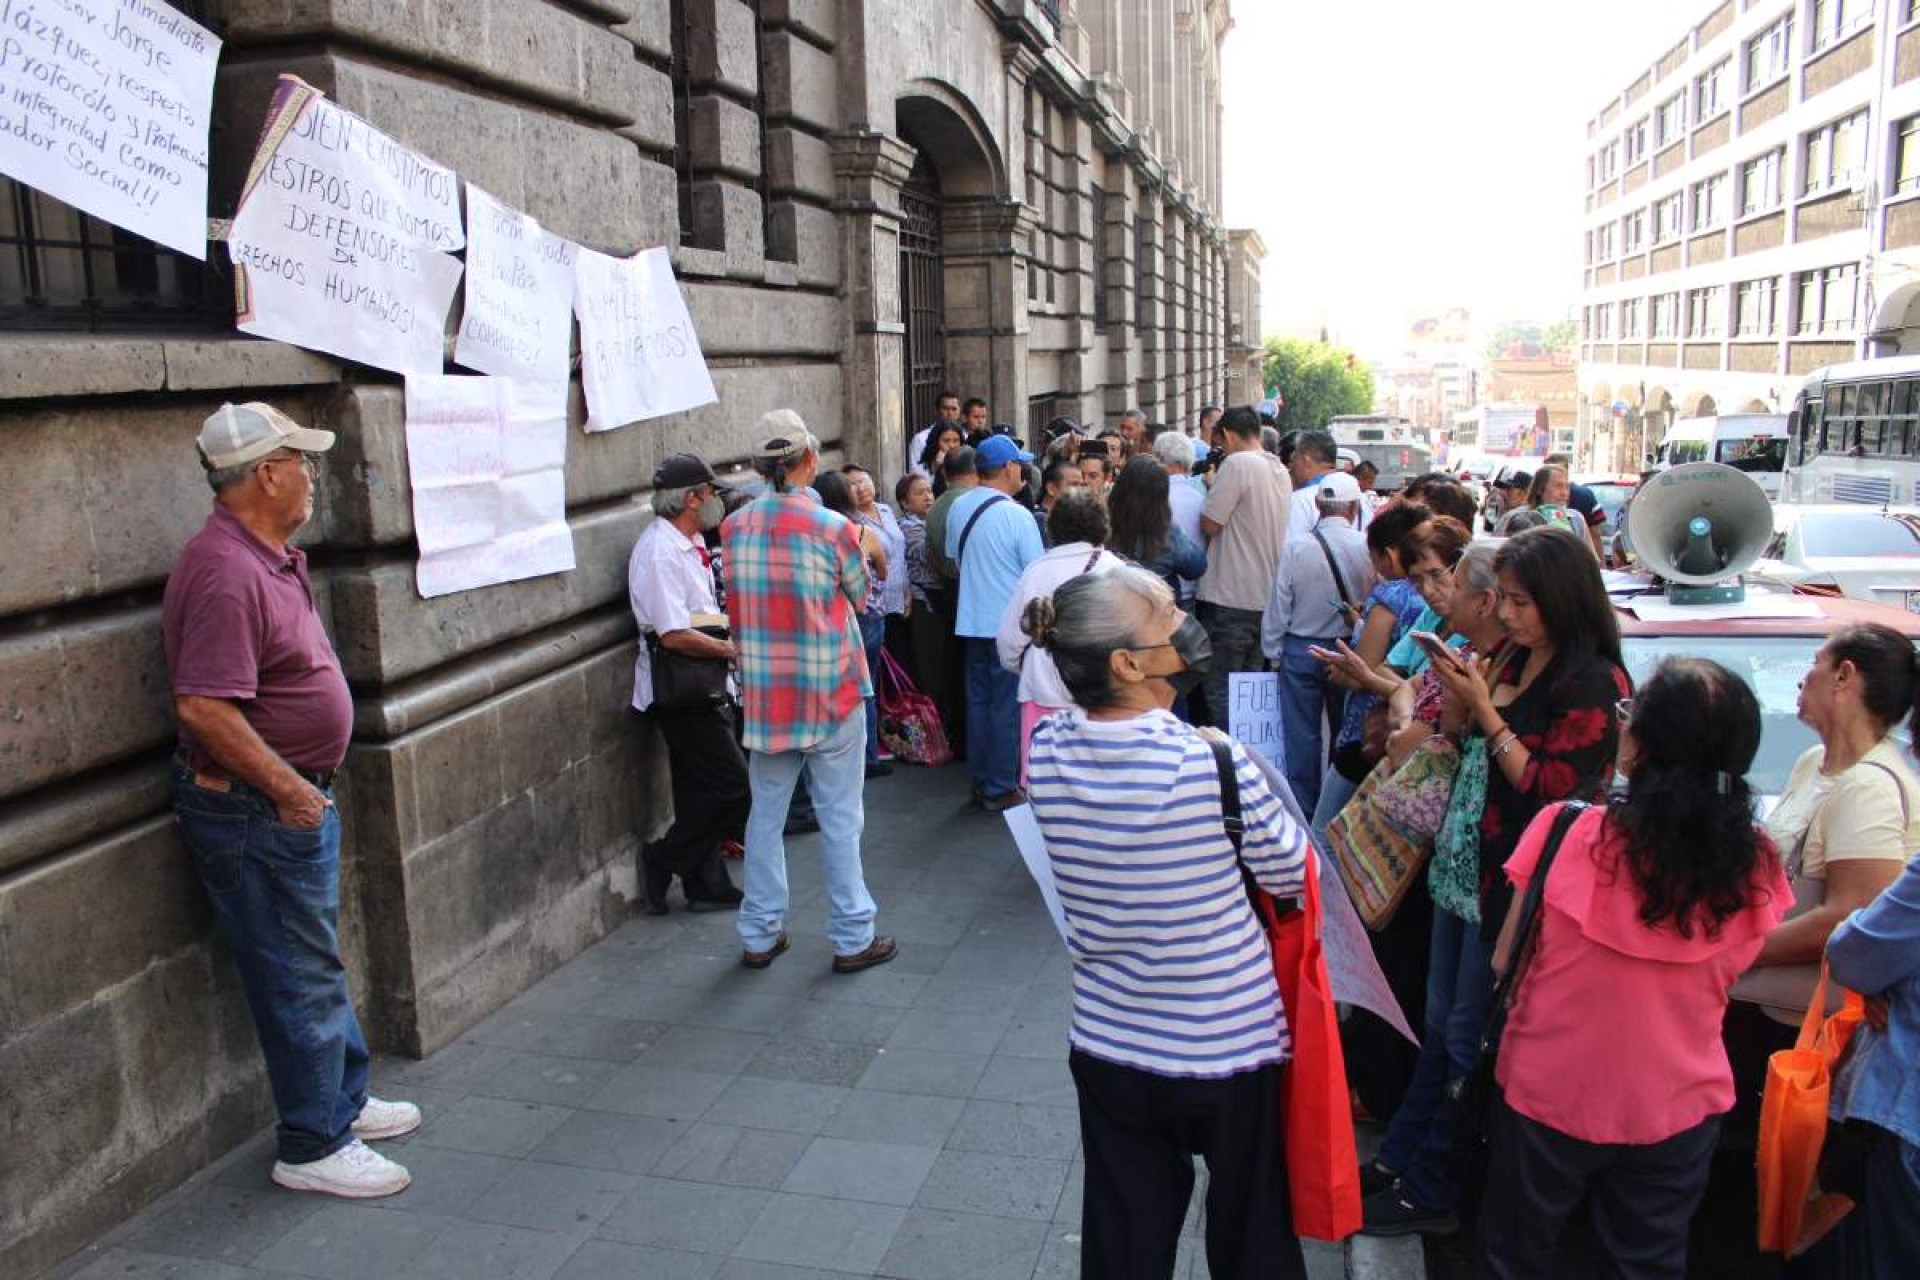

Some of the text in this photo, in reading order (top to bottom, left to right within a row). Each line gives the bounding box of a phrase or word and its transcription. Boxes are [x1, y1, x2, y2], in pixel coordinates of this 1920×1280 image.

[103, 9, 173, 76] Jorge
[118, 70, 196, 128] respeto
[123, 114, 139, 140] y
[12, 89, 182, 186] integridad Como
[263, 151, 352, 211] ESTROS
[361, 189, 388, 221] QUE
[396, 204, 456, 249] SOMOS
[283, 203, 417, 273] DEFENSORES
